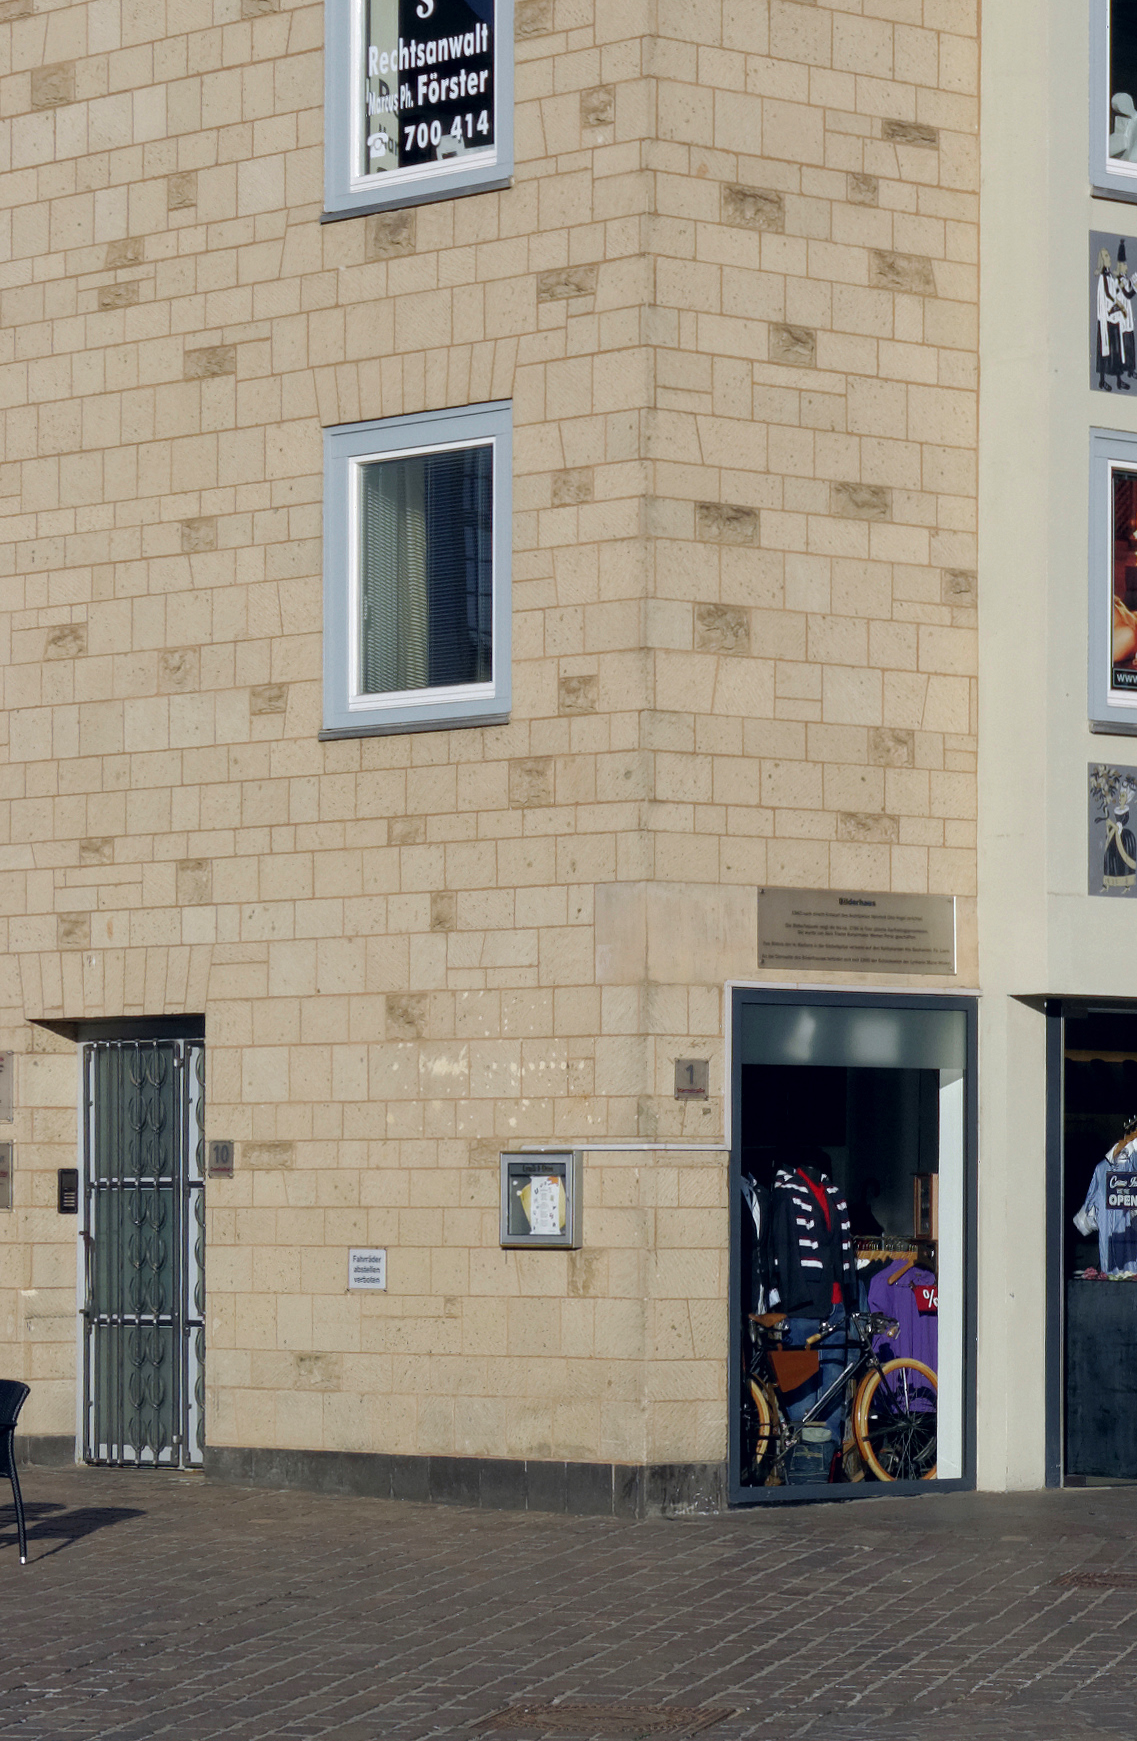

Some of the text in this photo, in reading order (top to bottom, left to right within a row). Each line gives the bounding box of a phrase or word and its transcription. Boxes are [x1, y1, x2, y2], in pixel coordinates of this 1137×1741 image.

[368, 23, 488, 77] Rechtsanwalt
[368, 91, 399, 117] Marcus
[400, 83, 414, 110] Ph.
[417, 69, 488, 106] Förster
[403, 119, 442, 151] 700
[451, 110, 489, 141] 414
[685, 1064, 694, 1085] 1
[213, 1145, 229, 1164] 10
